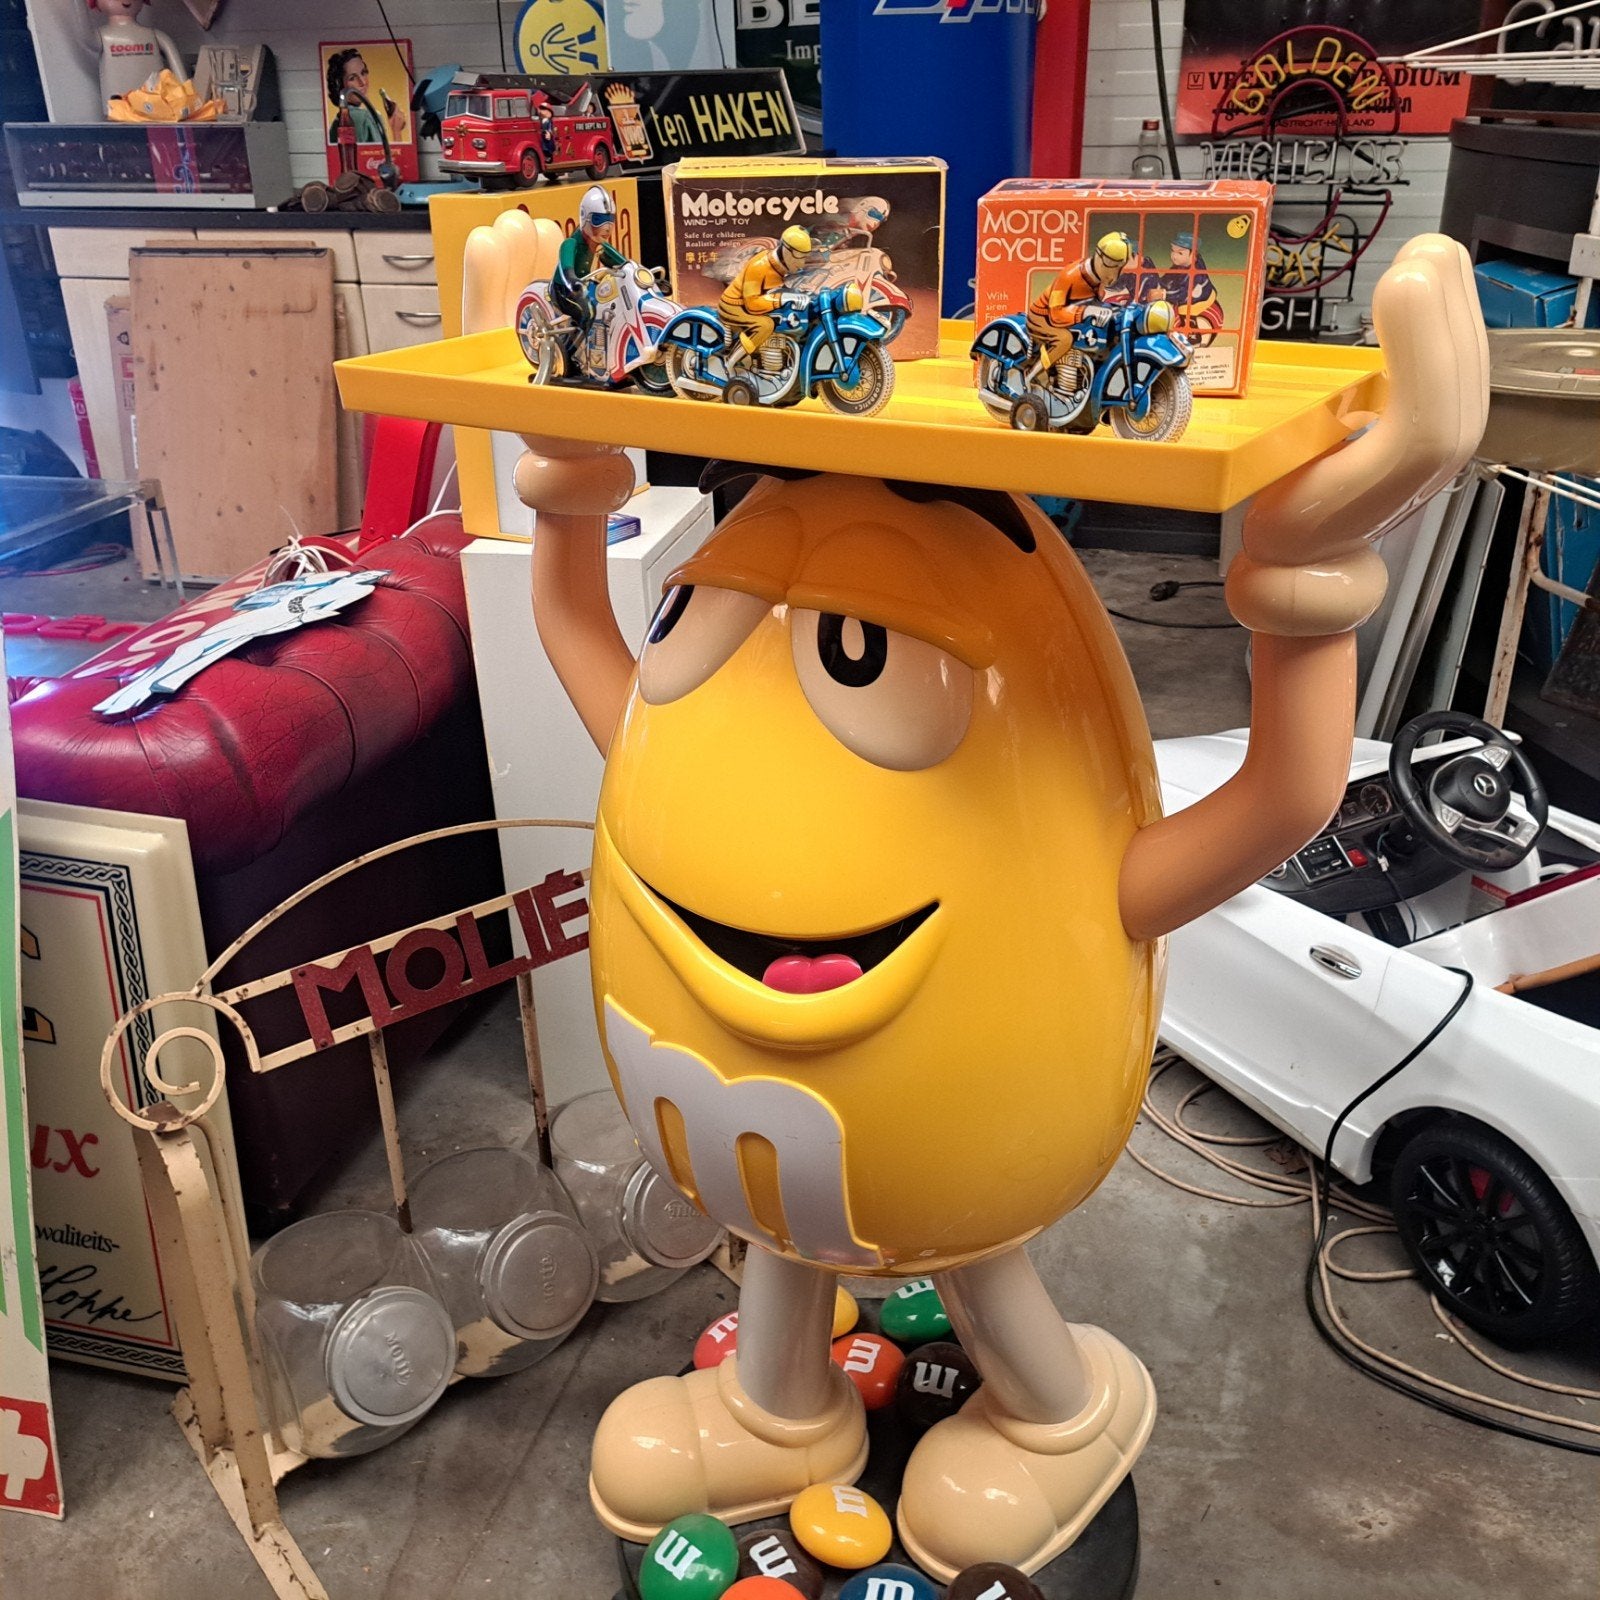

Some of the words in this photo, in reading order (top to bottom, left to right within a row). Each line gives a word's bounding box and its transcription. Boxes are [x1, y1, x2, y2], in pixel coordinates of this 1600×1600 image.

[1232, 36, 1391, 113] GOLDEN
[650, 106, 692, 147] ten
[689, 90, 792, 143] HAKEN
[681, 189, 839, 221] Motorcycle
[1073, 189, 1261, 199] MOTORCYCLE
[683, 218, 728, 226] WIND-UP
[732, 217, 750, 225] TOY
[982, 209, 1082, 234] MOTOR-
[684, 231, 700, 239] Safe
[702, 231, 714, 239] for
[716, 230, 746, 238] children
[685, 240, 716, 248] Realistic
[718, 239, 741, 248] design
[980, 237, 1065, 262] CYCLE
[985, 303, 1008, 311] siren
[986, 291, 1009, 301] With
[34, 1223, 121, 1253] waliteits-
[912, 1361, 960, 1399] m
[654, 1529, 703, 1581] m
